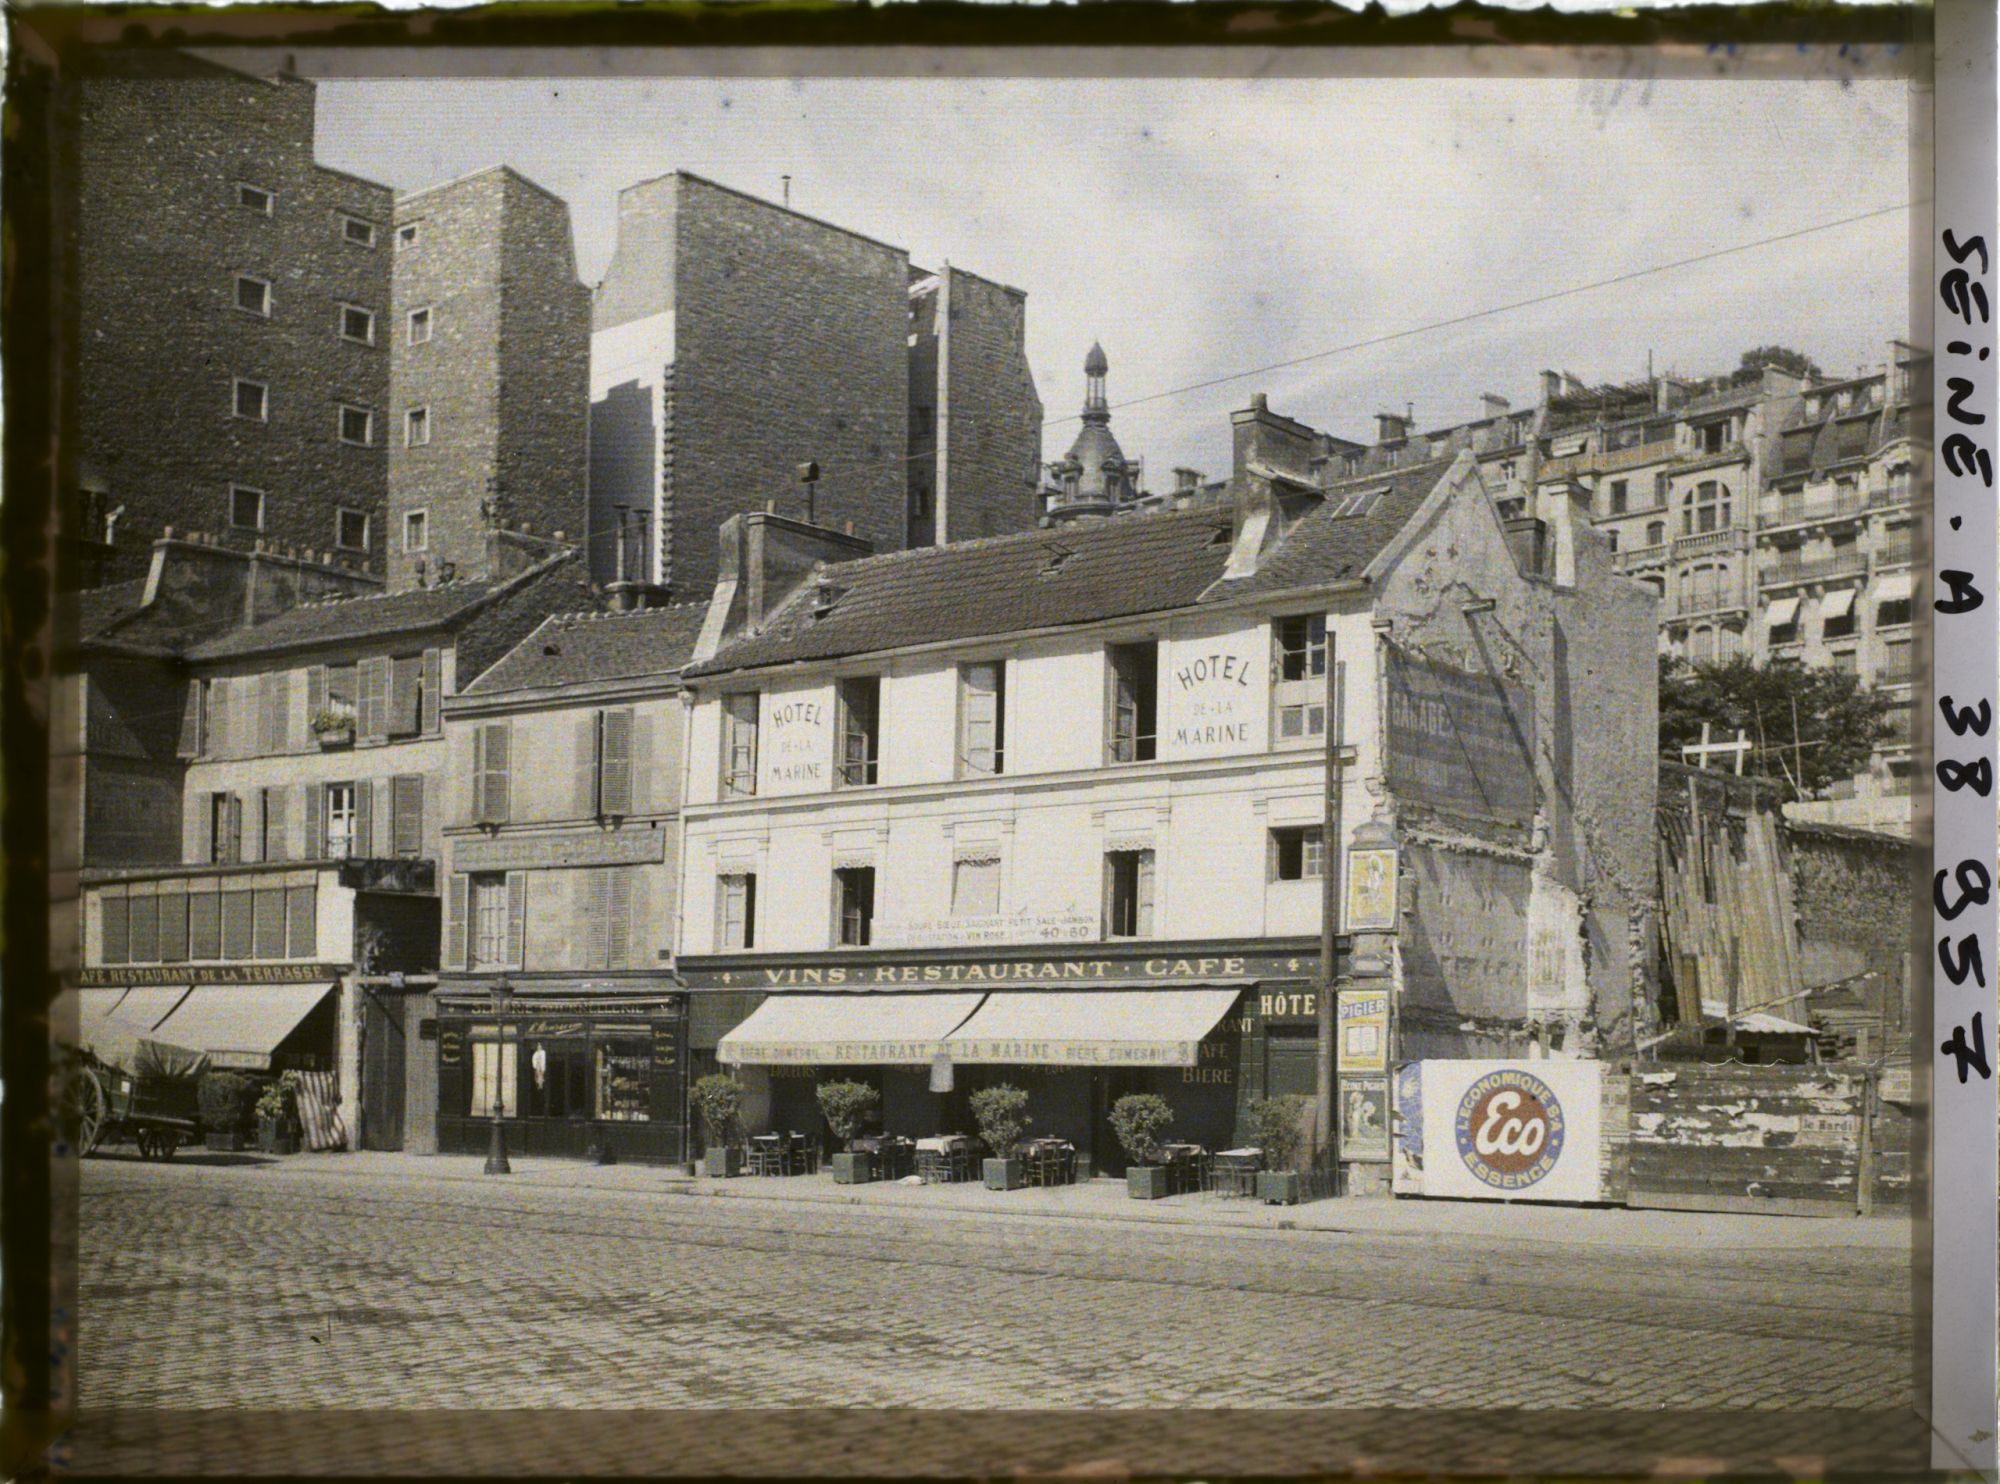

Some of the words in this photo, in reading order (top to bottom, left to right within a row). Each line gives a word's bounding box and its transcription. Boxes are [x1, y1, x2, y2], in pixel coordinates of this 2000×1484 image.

[1933, 568, 1984, 615] A
[1177, 655, 1249, 690] HOTEL
[773, 703, 821, 729] HOTEL
[1172, 722, 1249, 745] MARINE
[772, 762, 821, 780] MARINE
[110, 968, 196, 984] RESTAURANT
[201, 969, 216, 980] DE
[221, 969, 237, 981] LA
[241, 965, 323, 980] TERRASSE
[765, 967, 847, 984] VINS
[874, 960, 1113, 983] RESTAURANT
[1259, 991, 1316, 1016] HÔTE
[1340, 1000, 1386, 1019] PIGIER
[834, 1043, 926, 1060] RESTAURANT
[961, 1043, 979, 1058] LA
[991, 1043, 1050, 1059] MARINE
[1475, 1090, 1545, 1156] Eco
[1463, 1151, 1555, 1188] ESSENCE
